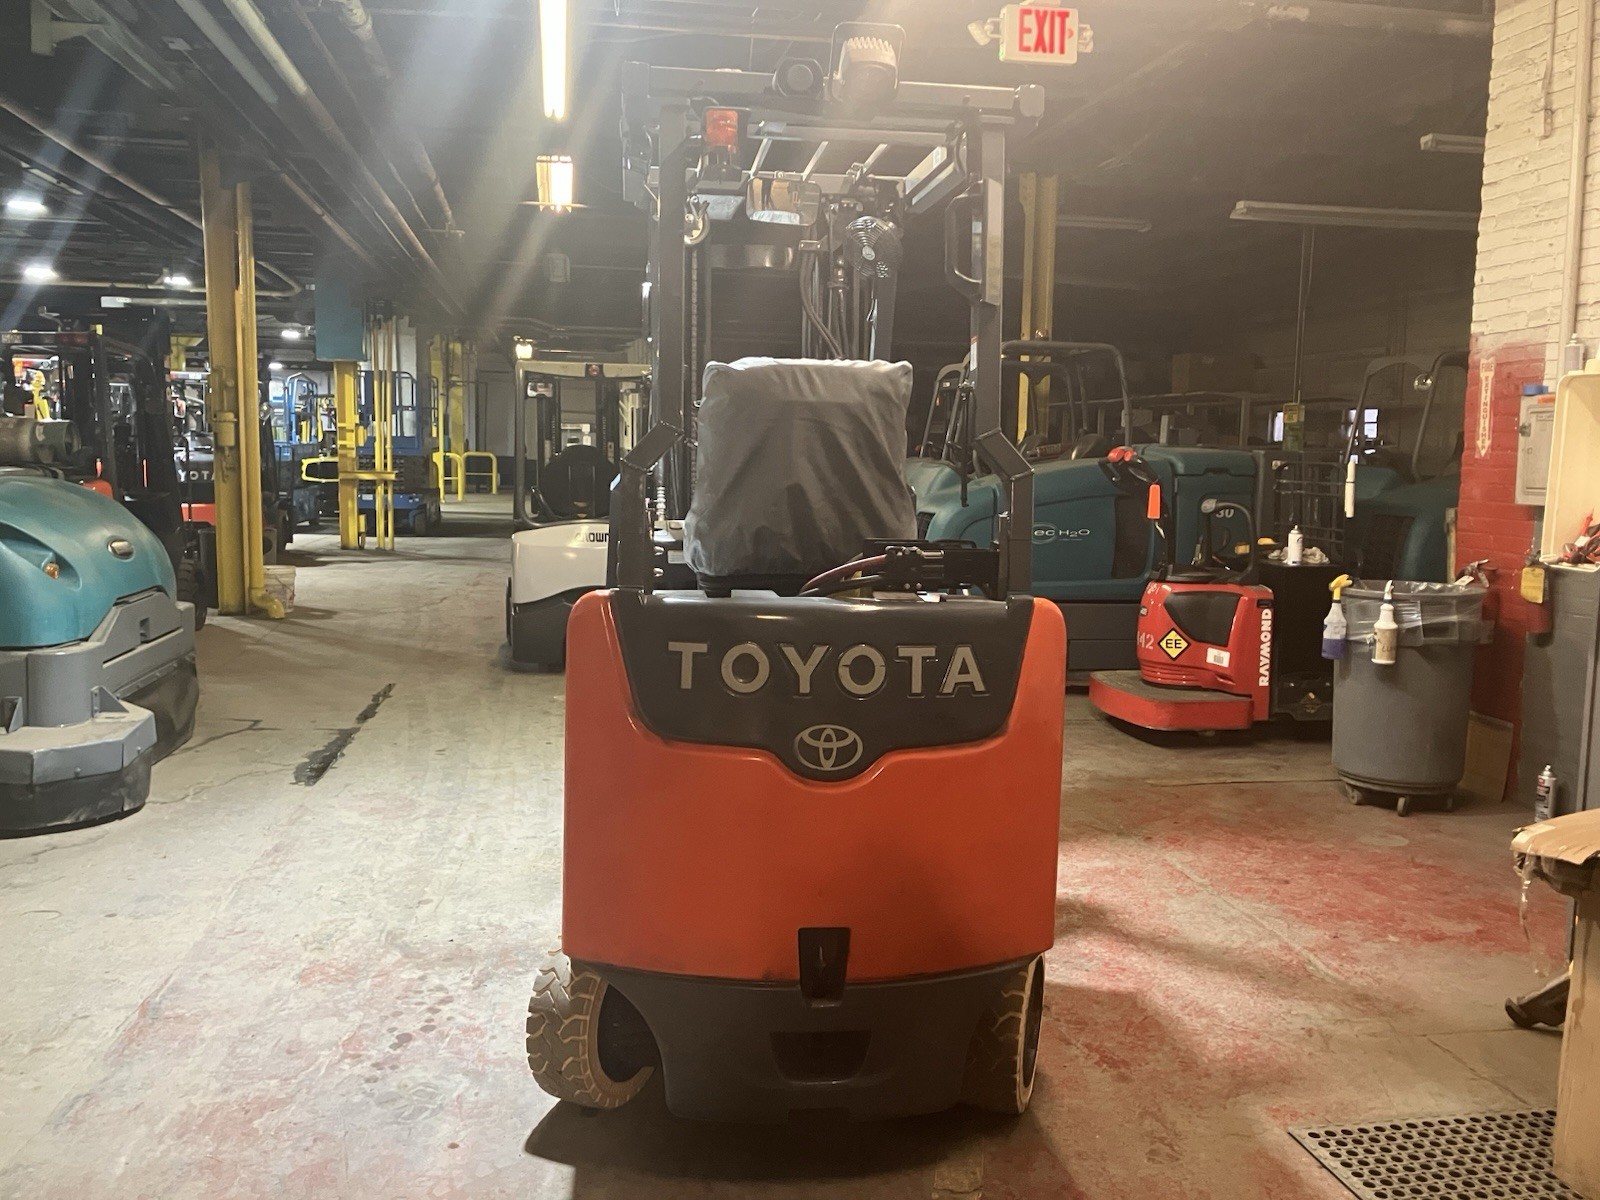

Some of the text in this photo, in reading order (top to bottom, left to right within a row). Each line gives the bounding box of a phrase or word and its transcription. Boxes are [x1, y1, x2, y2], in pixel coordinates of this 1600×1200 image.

[1018, 8, 1070, 55] EXIT
[1481, 375, 1490, 450] EXTINGUISHER
[667, 641, 988, 697] TOYOTA
[1165, 638, 1183, 649] EE
[1259, 608, 1272, 687] RAYMOND
